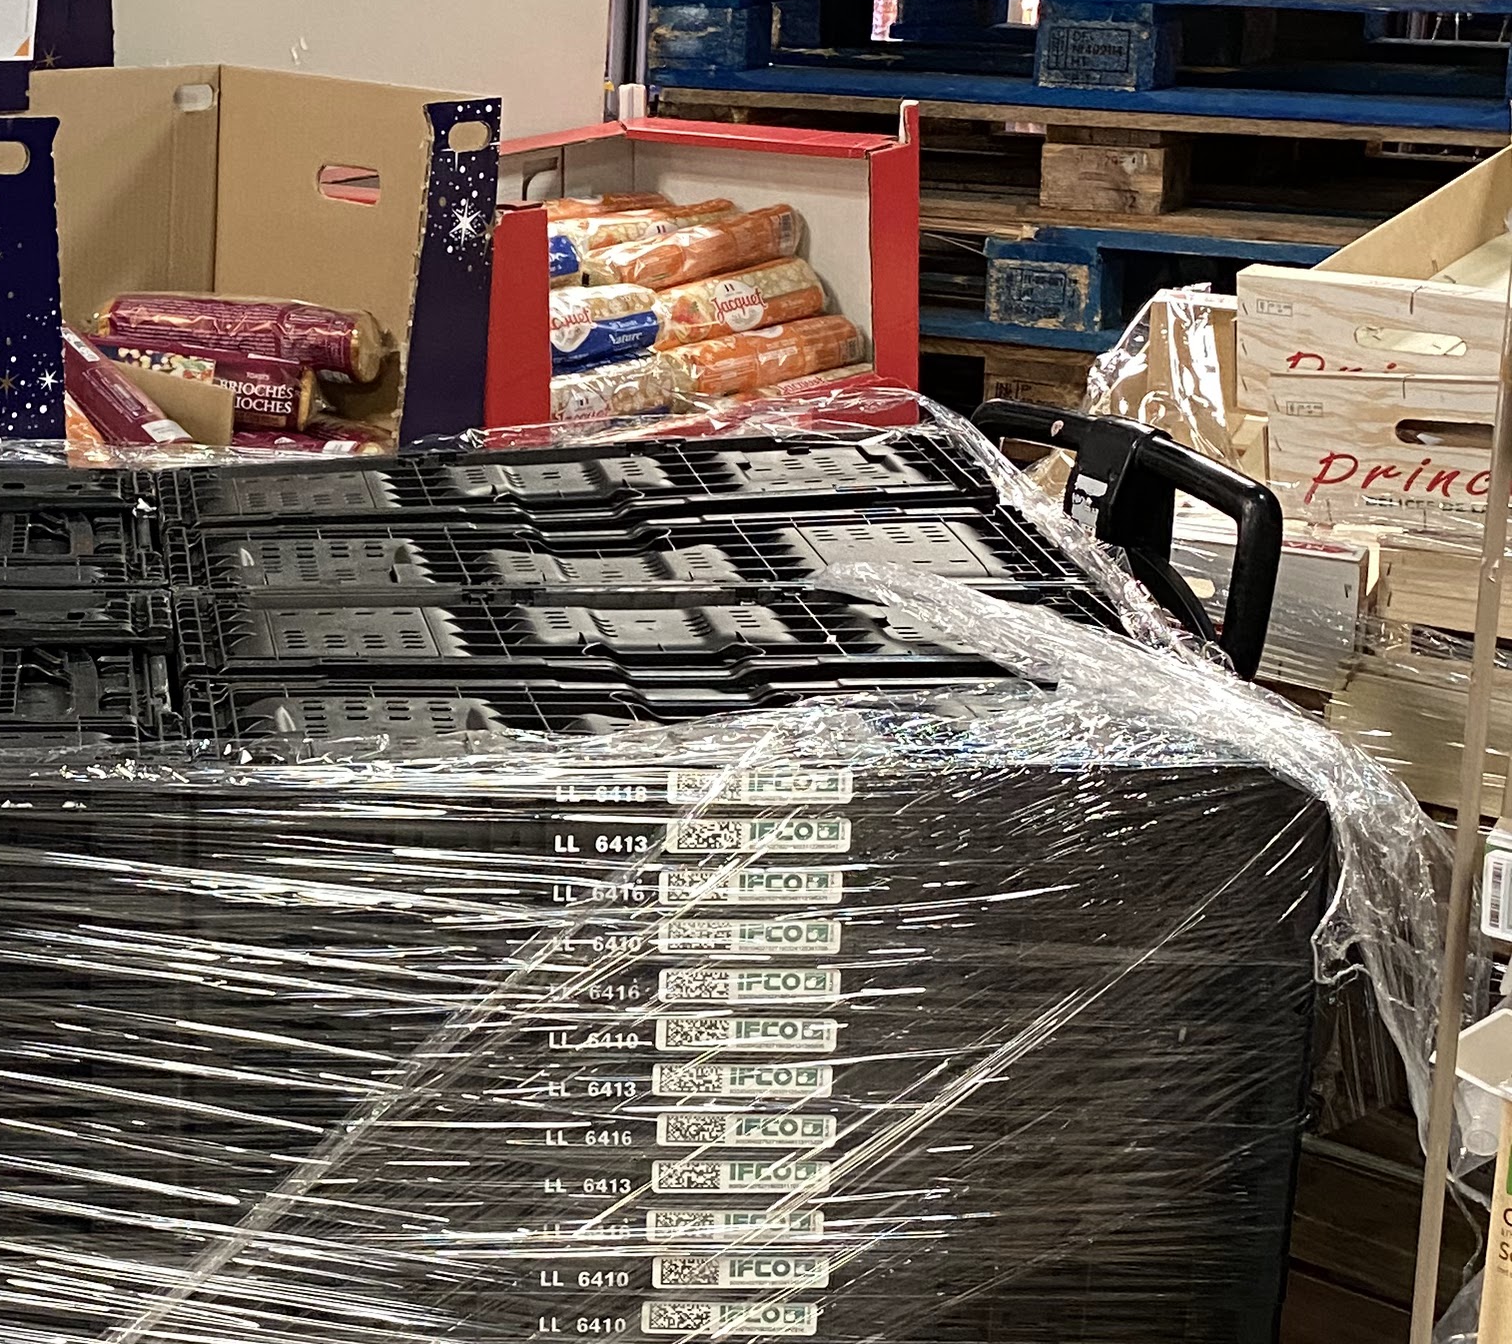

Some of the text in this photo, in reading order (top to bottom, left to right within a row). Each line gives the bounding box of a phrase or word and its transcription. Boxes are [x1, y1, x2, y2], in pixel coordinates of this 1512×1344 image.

[711, 288, 768, 324] Jacquet
[234, 396, 292, 414] IOCHES
[555, 821, 813, 853] LL 6413 IFCO
